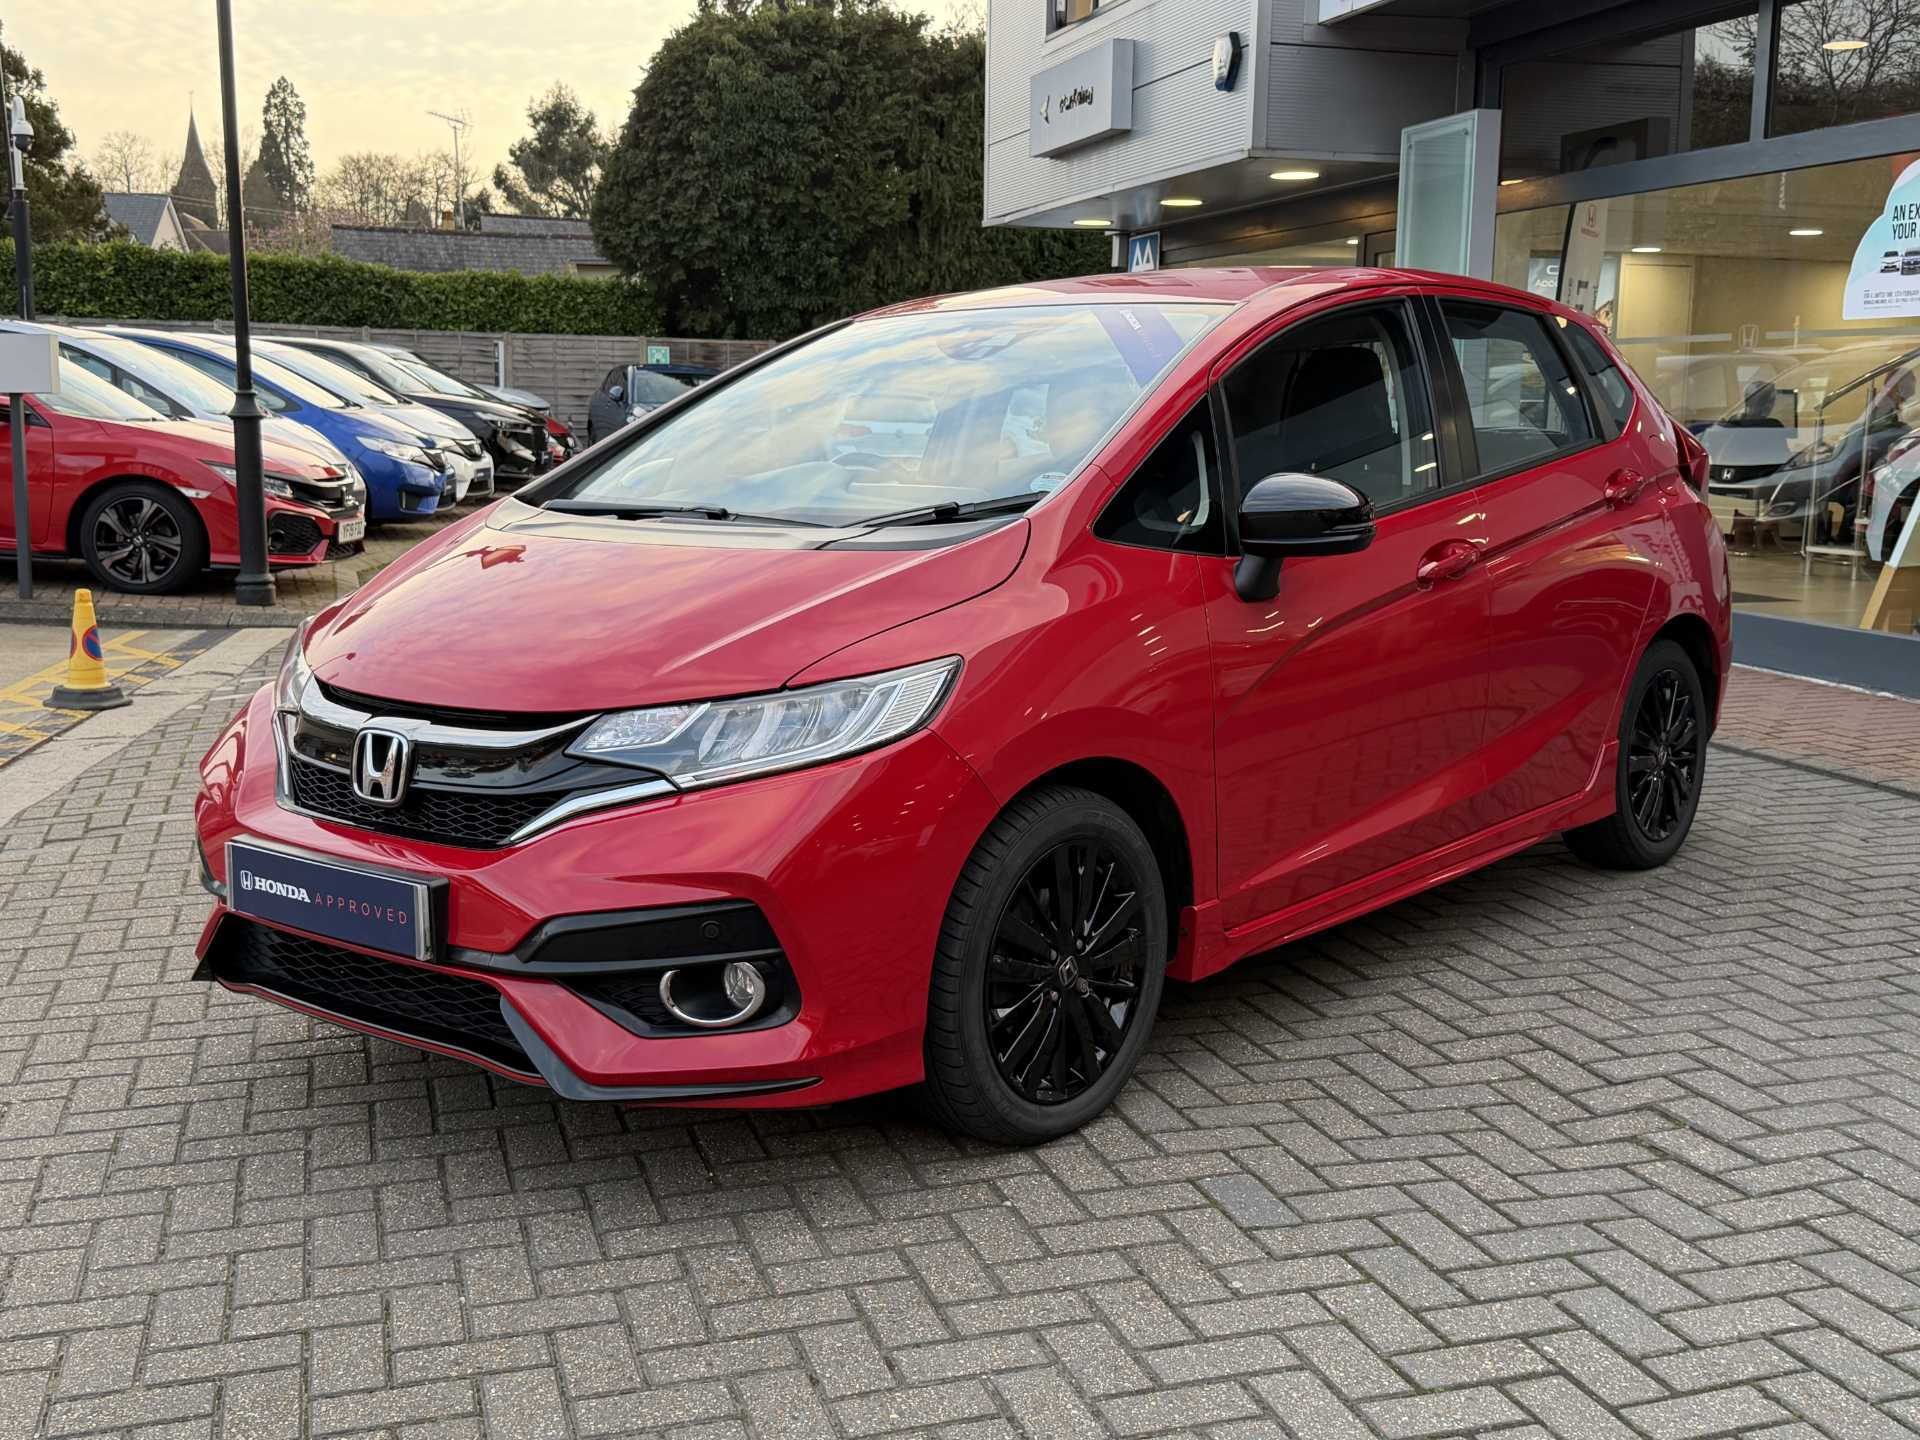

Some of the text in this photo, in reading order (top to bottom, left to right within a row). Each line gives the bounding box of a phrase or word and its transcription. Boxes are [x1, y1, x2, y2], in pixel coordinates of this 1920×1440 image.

[1892, 204, 1907, 222] AN
[1892, 221, 1917, 241] YOUR
[254, 876, 311, 903] HONDA
[314, 892, 408, 925] APPROVED
